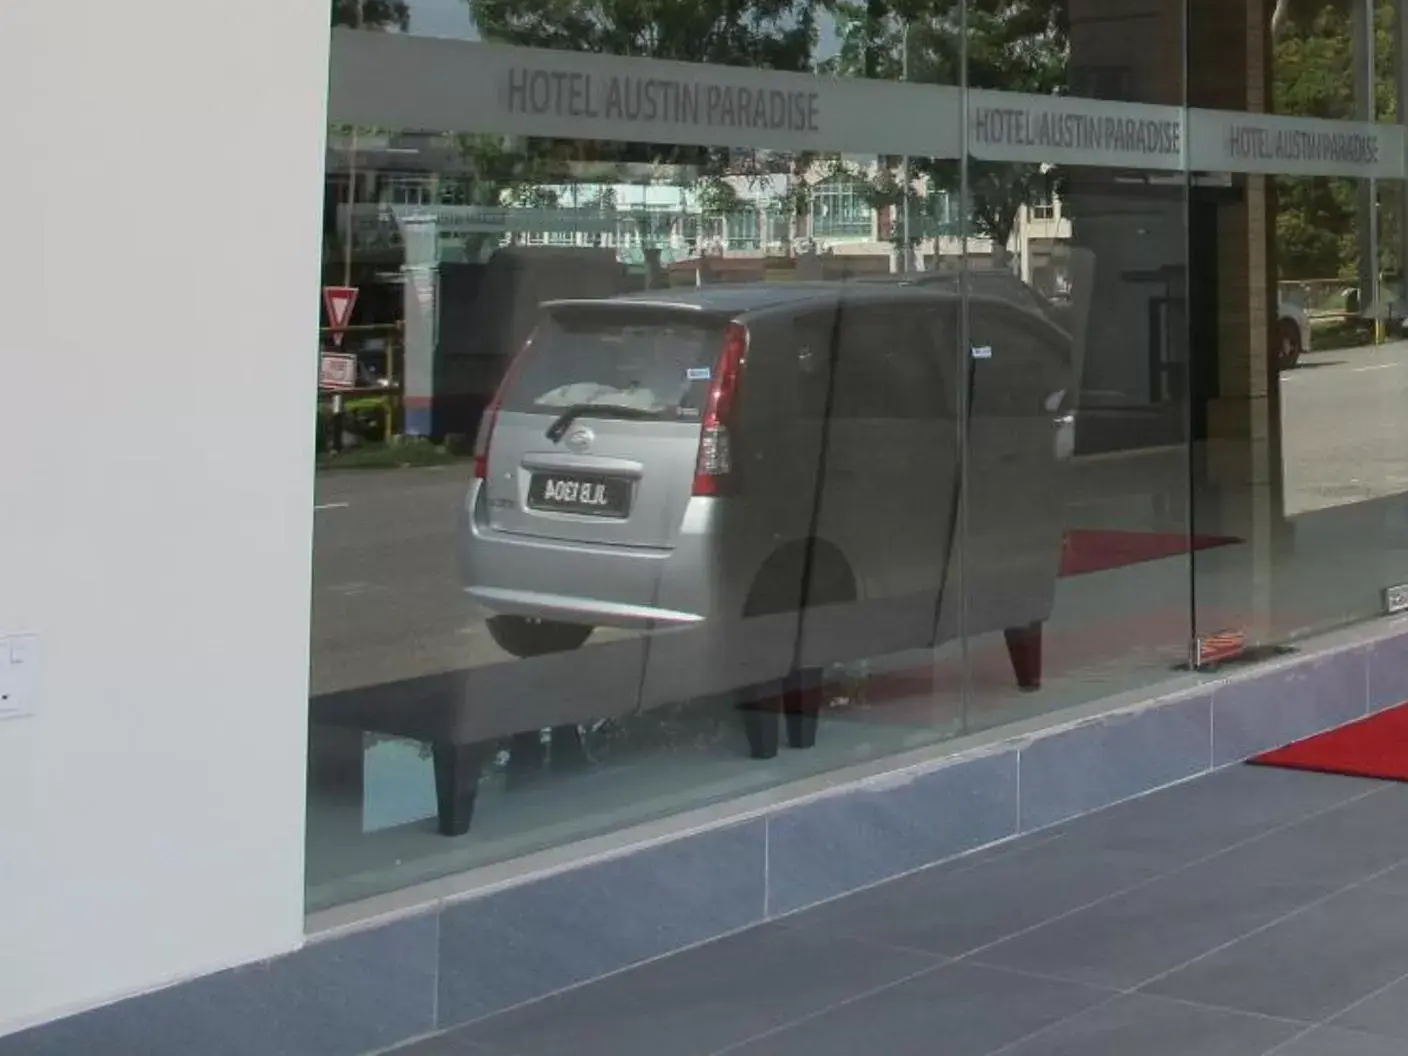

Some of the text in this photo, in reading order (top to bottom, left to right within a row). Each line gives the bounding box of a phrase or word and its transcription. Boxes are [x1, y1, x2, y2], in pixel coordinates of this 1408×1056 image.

[508, 67, 820, 132] HOTEL AUSTIN PARADISE
[975, 108, 1181, 154] HOTEL AUSTIN PARADISE
[1230, 124, 1273, 159] HOTEL
